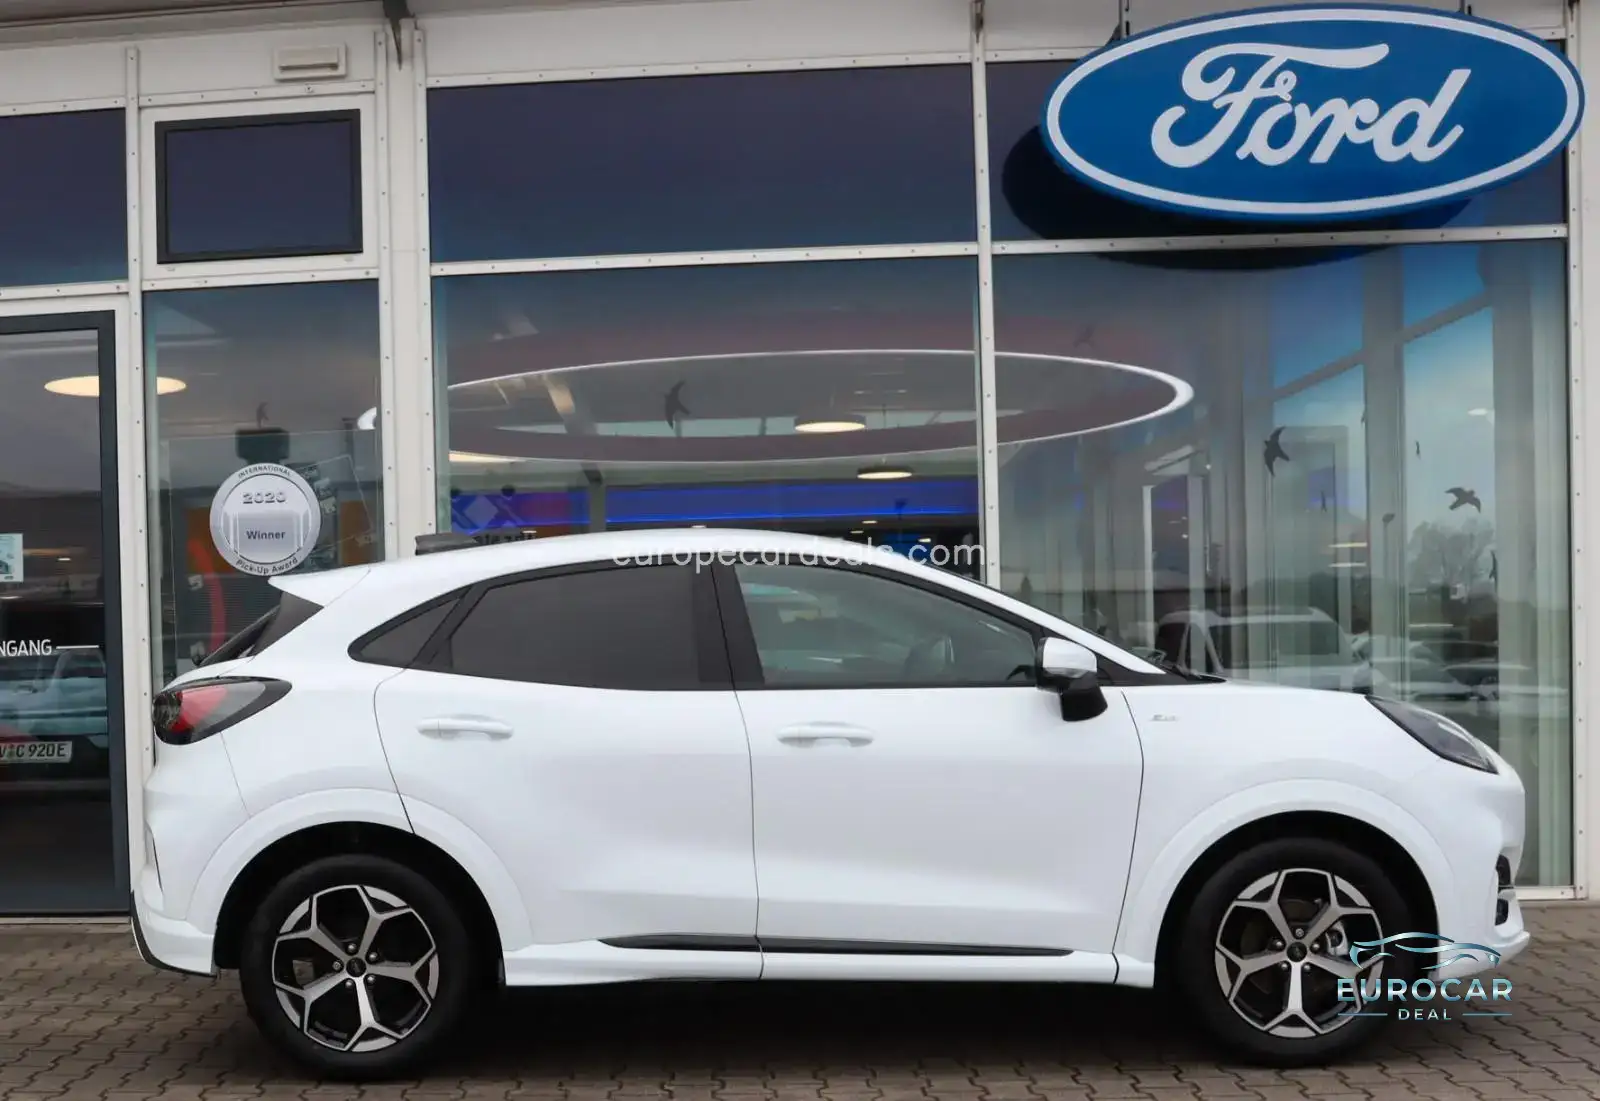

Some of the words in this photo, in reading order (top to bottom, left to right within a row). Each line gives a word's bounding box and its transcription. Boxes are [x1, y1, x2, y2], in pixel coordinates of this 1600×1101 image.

[1151, 42, 1471, 168] Ford
[238, 465, 292, 478] INTERNATIONAL
[242, 491, 287, 504] 2020
[246, 529, 286, 540] Winner
[235, 559, 270, 574] Pick-Up
[271, 557, 298, 572] Award
